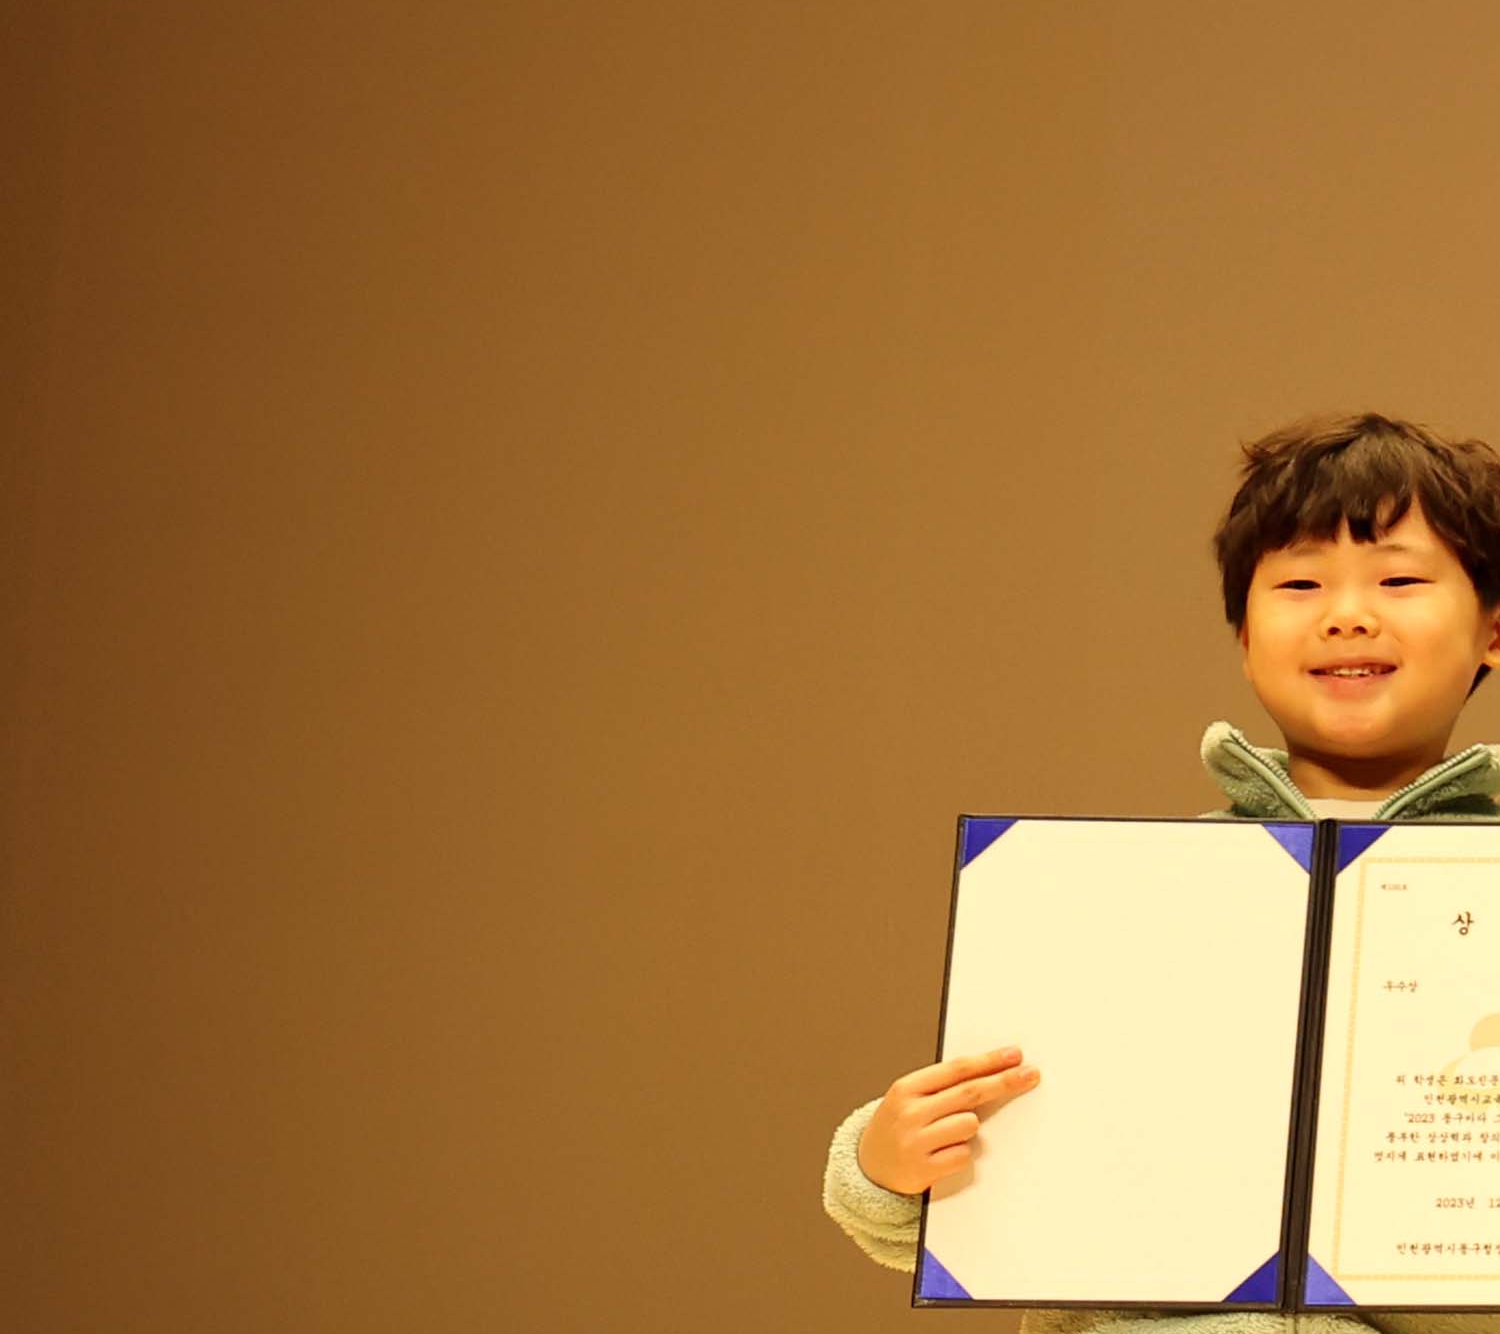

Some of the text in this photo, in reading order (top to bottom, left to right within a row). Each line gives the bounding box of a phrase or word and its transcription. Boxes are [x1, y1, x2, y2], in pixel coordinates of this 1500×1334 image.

[1450, 909, 1476, 937] 상
[1382, 979, 1419, 993] 우수상
[1434, 1196, 1475, 1210] 2023년
